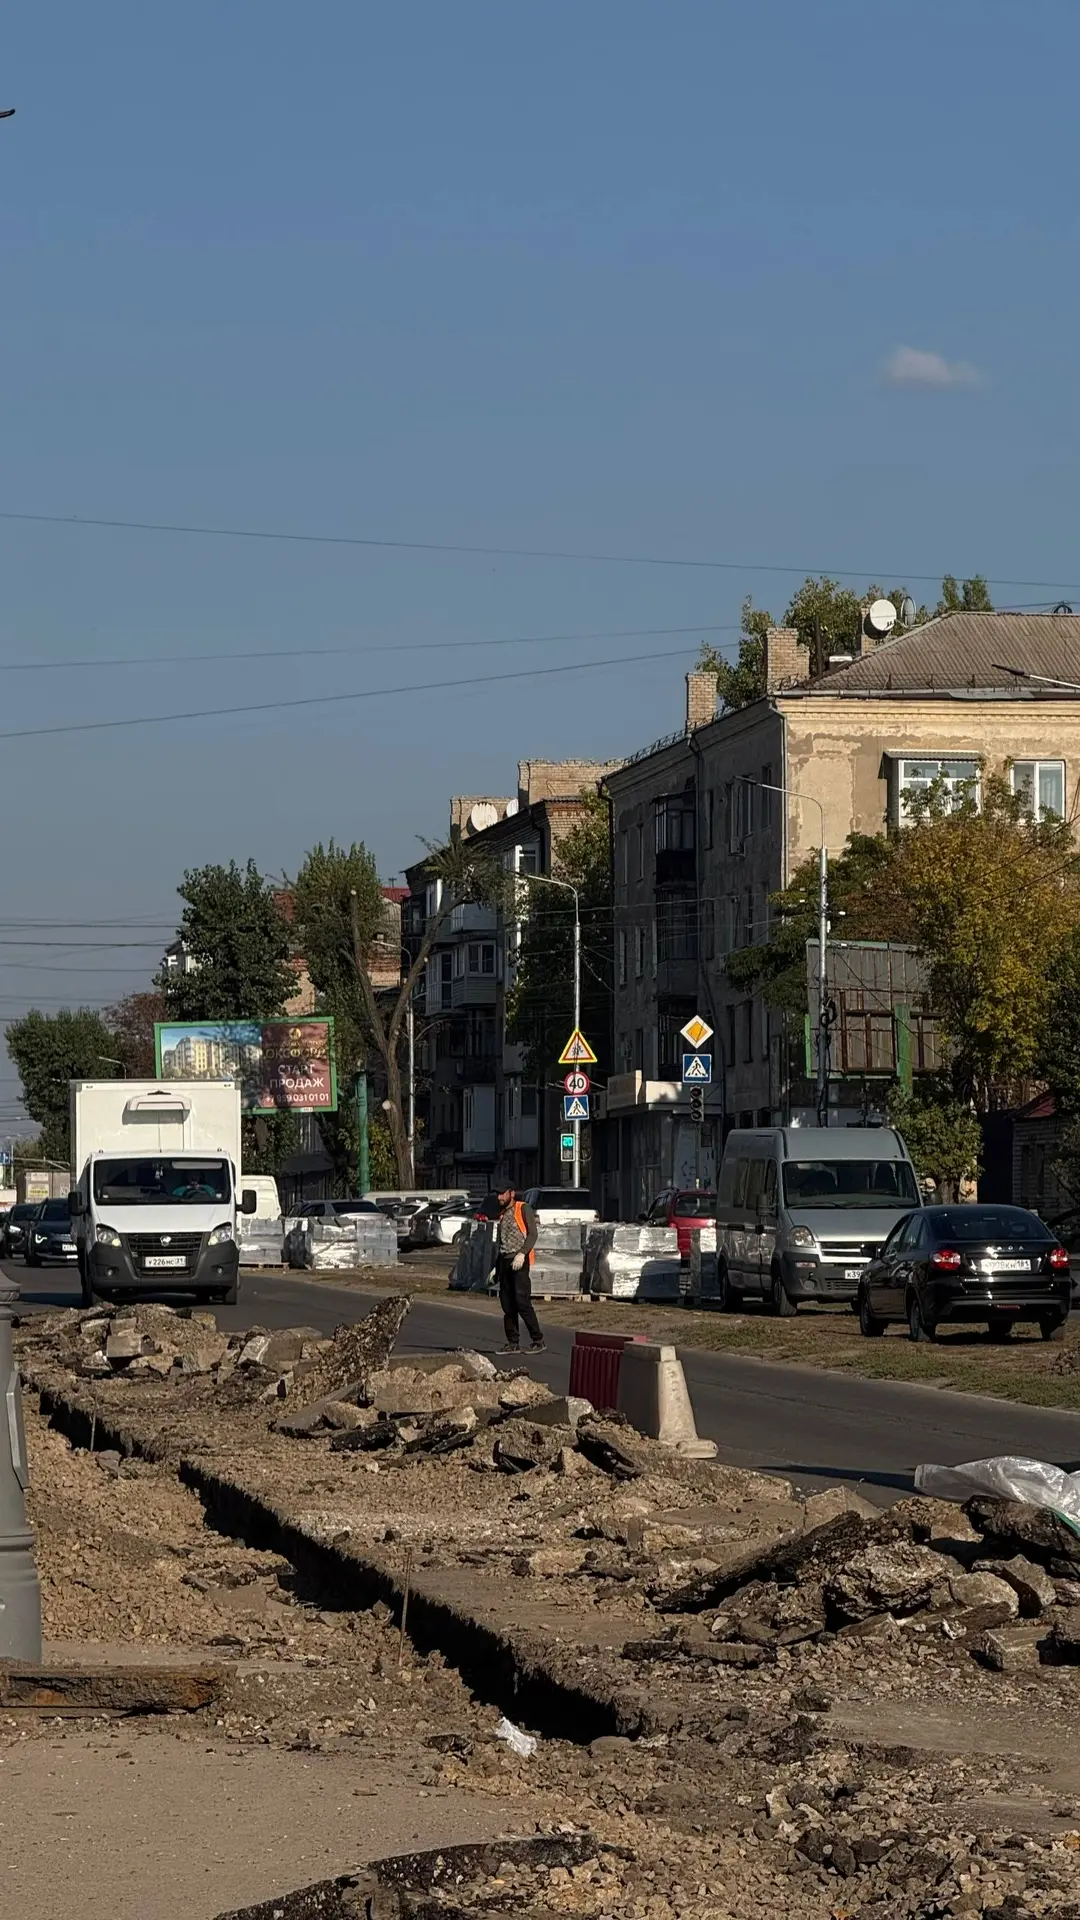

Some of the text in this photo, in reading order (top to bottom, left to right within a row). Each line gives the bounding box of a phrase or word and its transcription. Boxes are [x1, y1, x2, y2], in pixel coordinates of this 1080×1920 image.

[278, 1064, 315, 1075] СТАРТ
[270, 1078, 324, 1090] ПРОДАЖ
[569, 1077, 585, 1090] 40
[293, 1093, 308, 1102] 031
[309, 1093, 319, 1102] 01
[320, 1093, 329, 1101] 01
